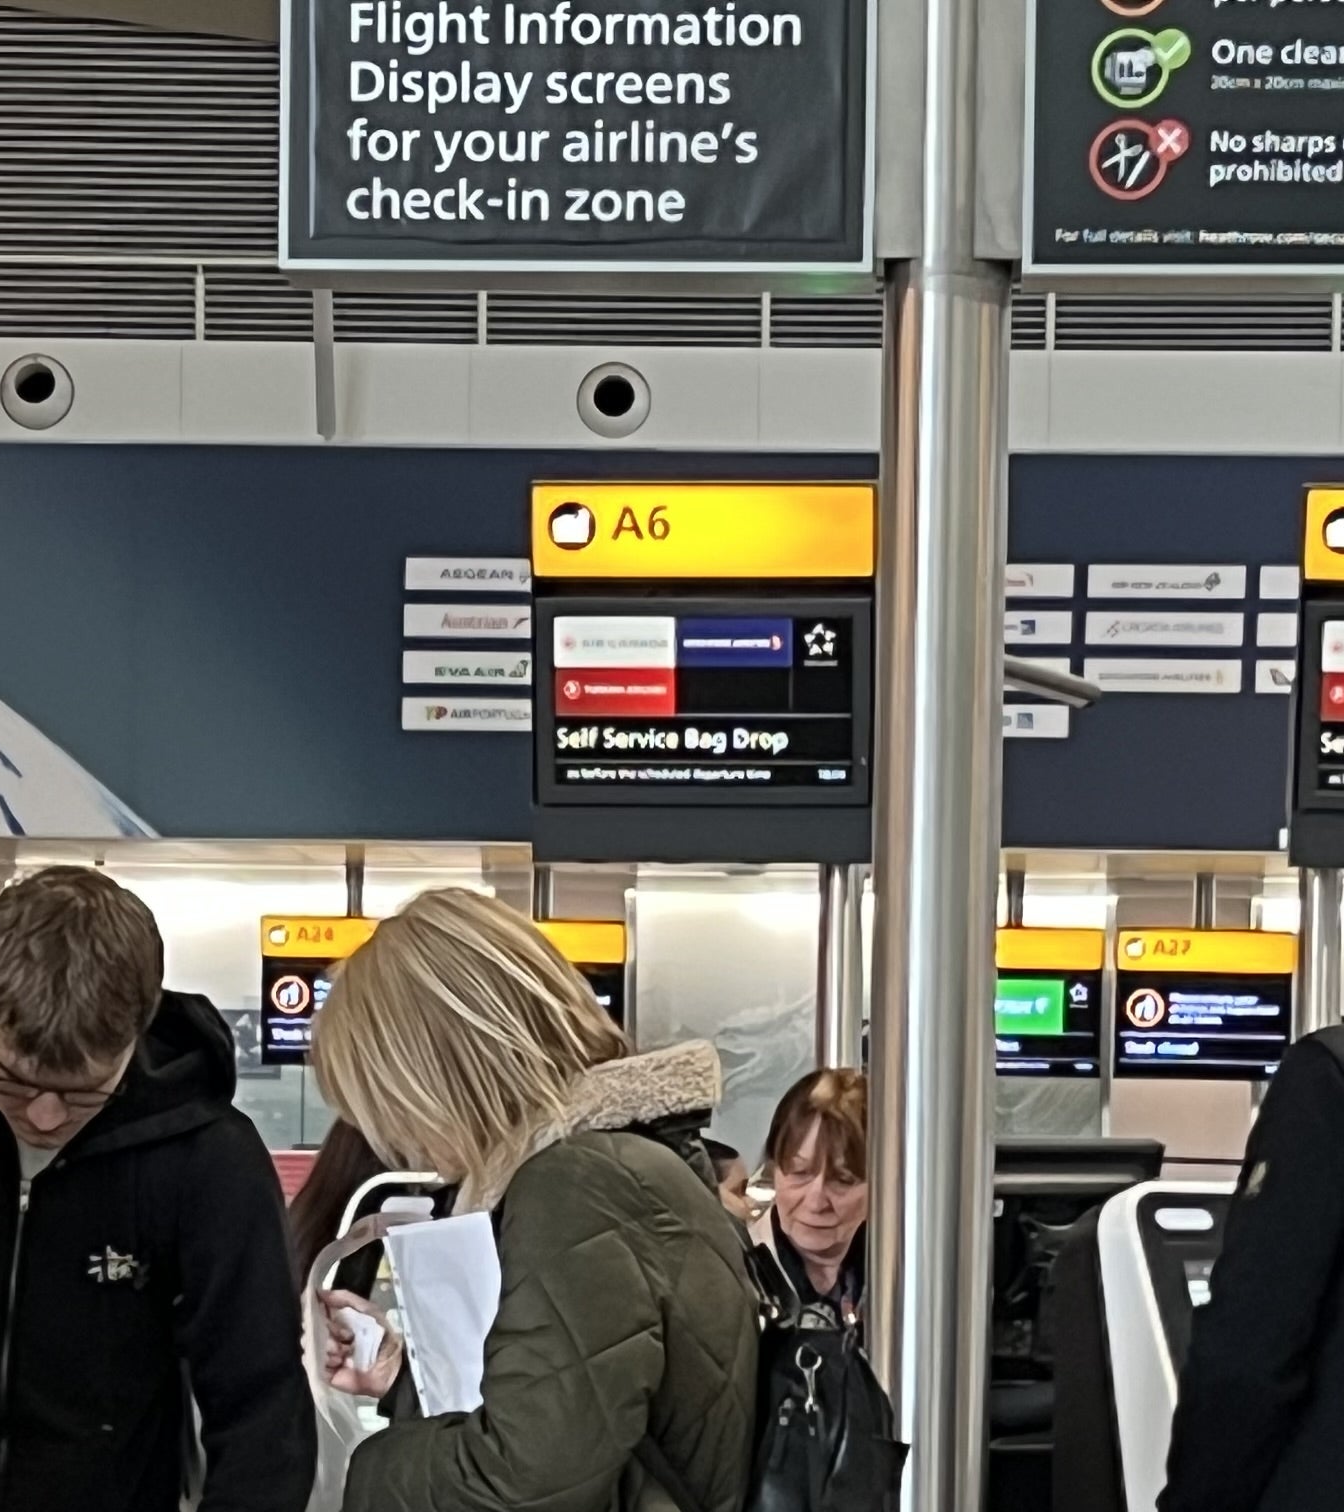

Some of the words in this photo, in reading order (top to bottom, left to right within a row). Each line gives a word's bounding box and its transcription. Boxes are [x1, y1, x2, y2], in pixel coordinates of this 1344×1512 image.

[350, 0, 489, 55] Flight
[505, 0, 802, 46] Information
[1211, 40, 1272, 66] One
[349, 59, 532, 113] Display
[546, 69, 730, 105] screens
[347, 118, 419, 162] for
[434, 128, 549, 172] your
[1210, 131, 1245, 154] No
[1251, 131, 1336, 159] sharps
[1209, 159, 1343, 187] prohibited
[346, 177, 550, 222] check-in
[565, 188, 686, 222] zone
[611, 505, 671, 541] A6
[557, 726, 599, 750] Self
[603, 727, 679, 750] Service
[684, 727, 728, 754] Bag
[733, 727, 789, 755] Drop
